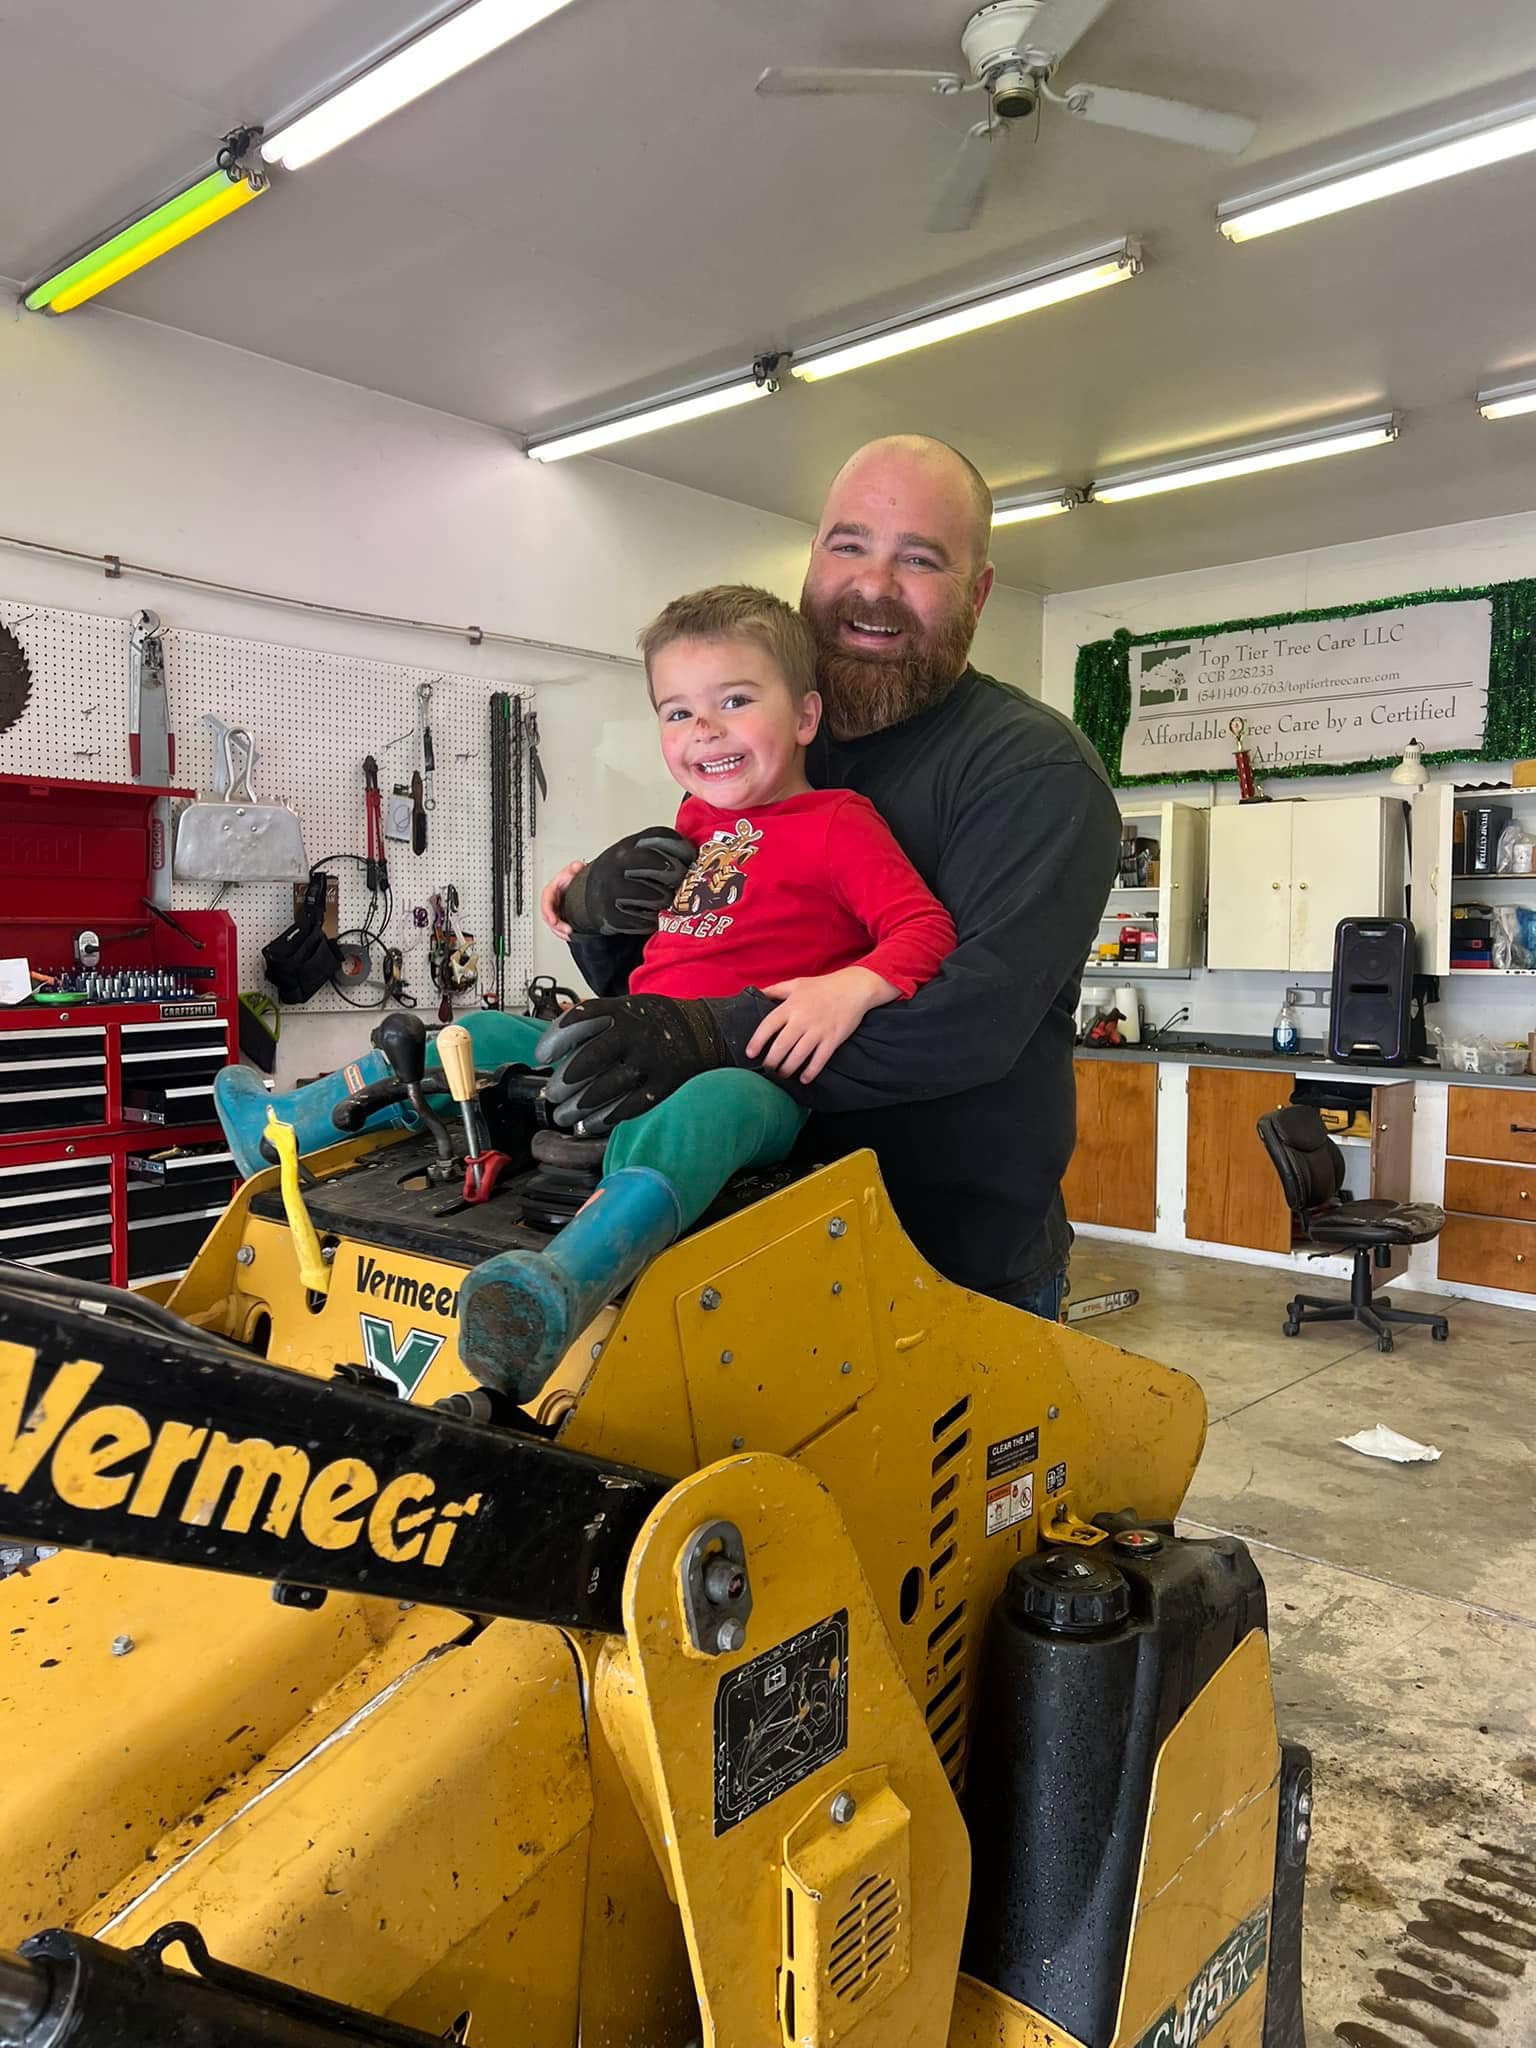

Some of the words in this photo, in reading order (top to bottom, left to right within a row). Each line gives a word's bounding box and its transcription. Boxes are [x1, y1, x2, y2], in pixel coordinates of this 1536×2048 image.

[1200, 649, 1230, 668] Top
[1236, 644, 1268, 661] Tier
[1274, 639, 1311, 656] Tree
[1317, 633, 1355, 652] Care
[1363, 624, 1405, 646] LLC
[1198, 671, 1225, 684] CCB
[1229, 664, 1274, 681] 228233
[1141, 719, 1226, 746] Affordable
[1241, 718, 1271, 737] ree
[1278, 714, 1320, 732] Care
[1327, 707, 1347, 733] by
[1353, 716, 1363, 727] a
[1371, 695, 1456, 725] Certified
[1251, 742, 1324, 764] Arborist
[152, 823, 164, 868] OREGON
[164, 1006, 214, 1016] CRAFTSMAN
[991, 1440, 1012, 1456] CLEAR
